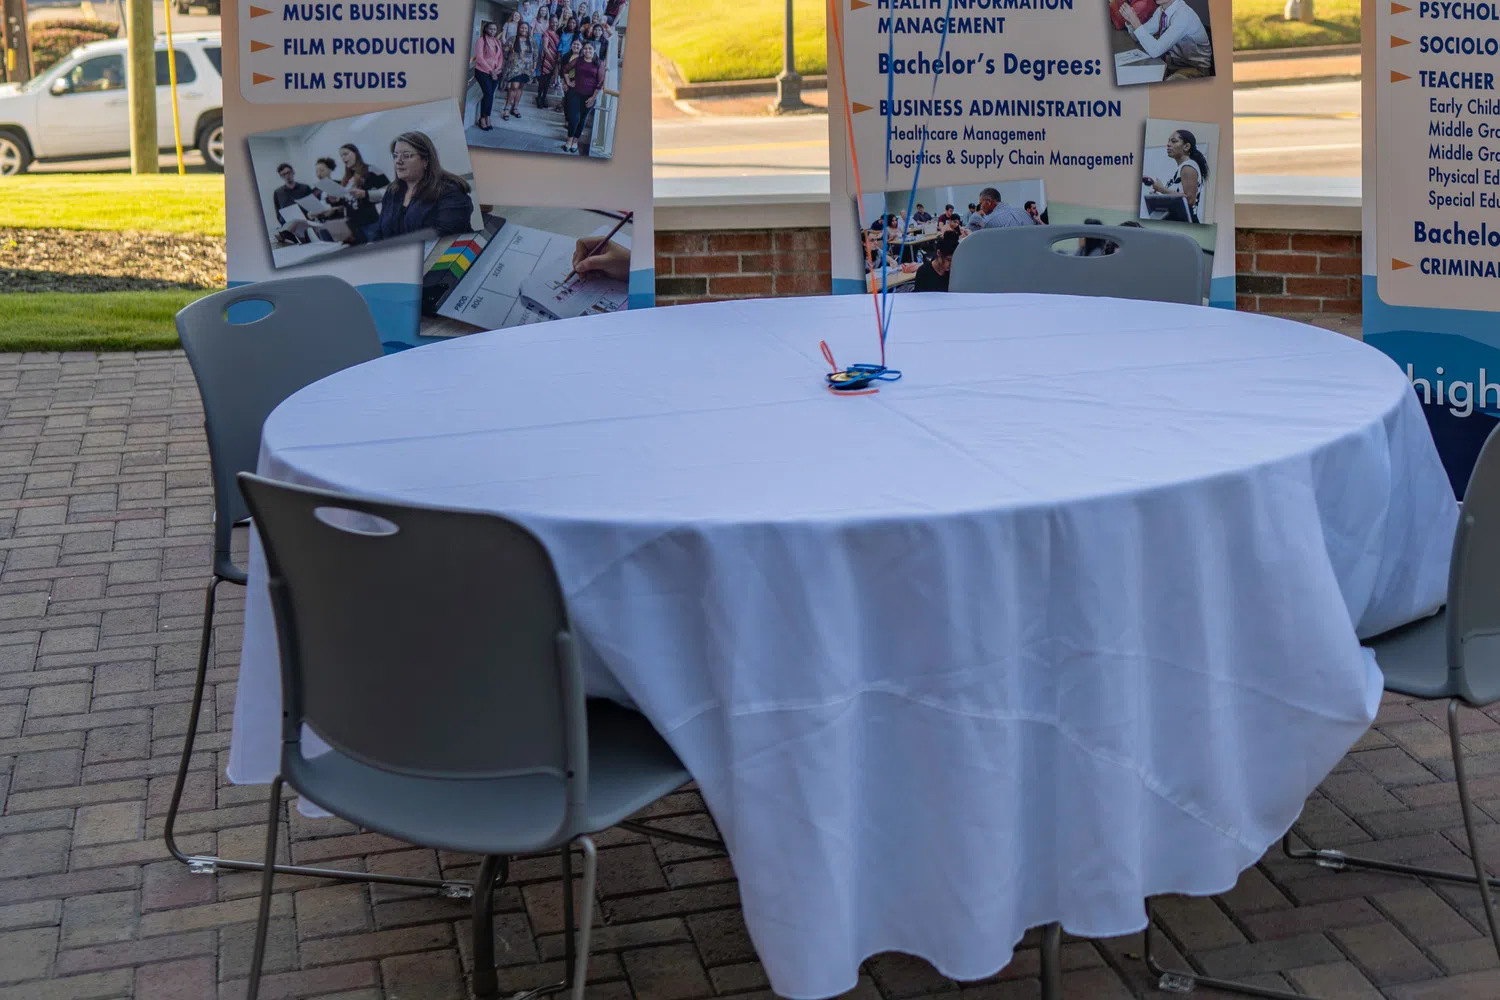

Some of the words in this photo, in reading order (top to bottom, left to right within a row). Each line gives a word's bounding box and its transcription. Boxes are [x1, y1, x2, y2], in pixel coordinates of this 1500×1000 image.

[283, 2, 342, 21] MUSIC
[349, 2, 438, 21] BUSINESS
[877, 16, 1005, 34] MANAGEMENT
[283, 37, 325, 55] FILM
[332, 36, 454, 55] PRODUCTION
[1003, 52, 1101, 81] Degrees:
[284, 71, 326, 89] FILM
[333, 71, 407, 89] STUDIES
[1418, 70, 1494, 90] TEACHER
[878, 98, 962, 117] BUSINESS
[968, 99, 1121, 117] ADMINISTRATION
[1429, 96, 1462, 117] Early
[887, 125, 958, 141] Healthcare
[963, 126, 1046, 144] Management
[1428, 120, 1473, 137] Middle
[888, 148, 941, 169] Logistics
[945, 149, 955, 164] &
[960, 148, 1004, 168] Supply
[1008, 149, 1044, 165] Chain
[1049, 151, 1134, 170] Management
[1428, 143, 1473, 160] Middle
[1428, 167, 1478, 186] Physical
[1428, 189, 1475, 208] Special
[491, 262, 506, 278] SCENE
[470, 294, 485, 310] ROLL
